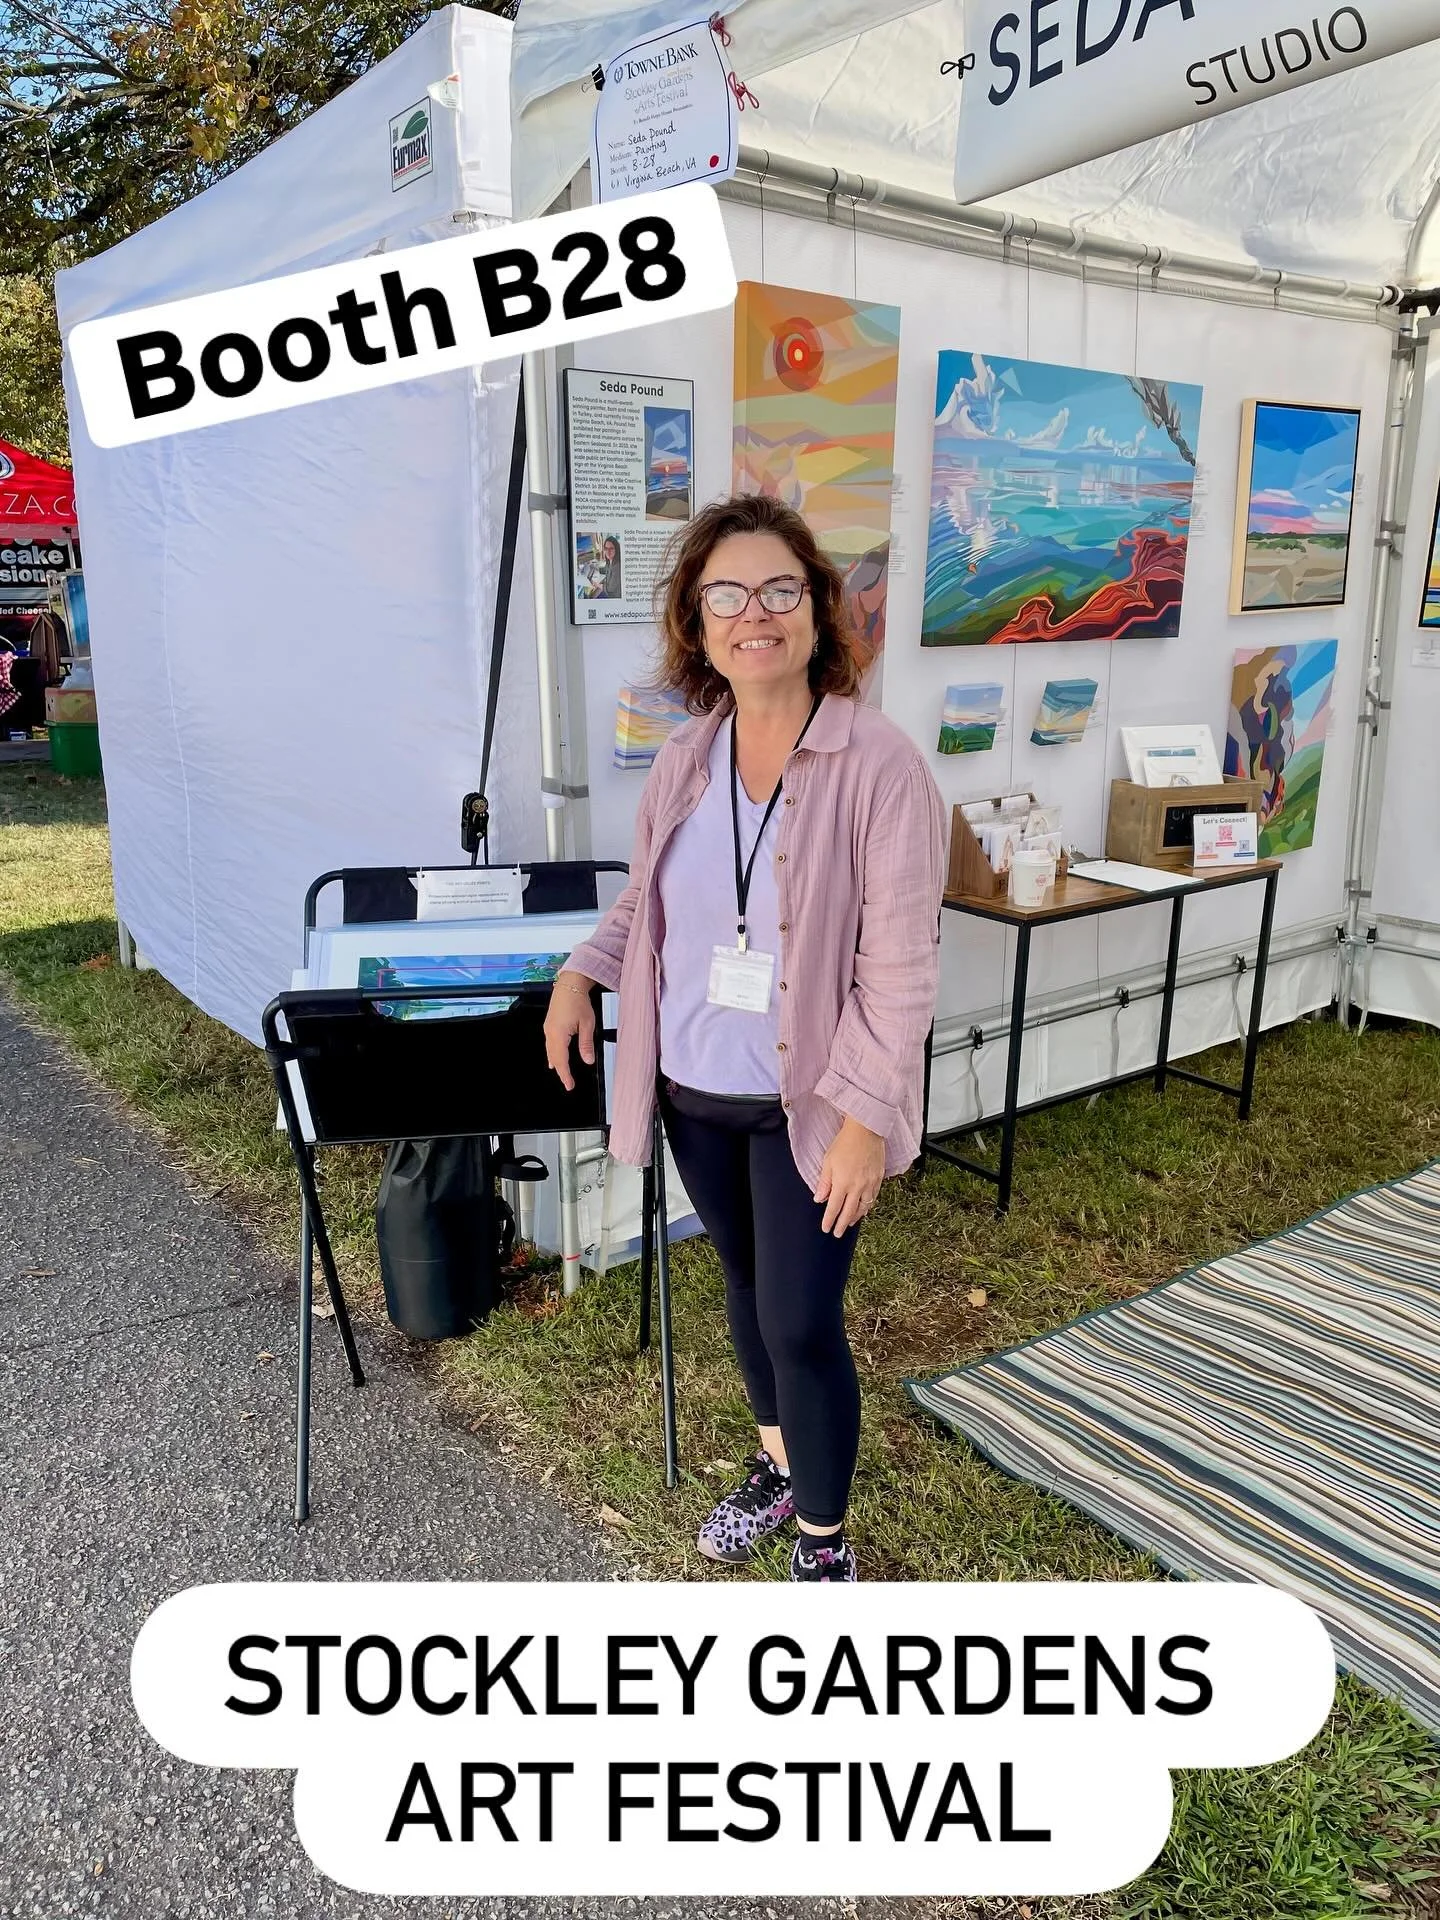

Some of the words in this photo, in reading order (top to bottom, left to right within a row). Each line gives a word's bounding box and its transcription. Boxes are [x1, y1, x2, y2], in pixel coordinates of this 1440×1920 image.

[1186, 7, 1367, 105] STUDIO
[624, 79, 658, 101] Stockley
[659, 70, 694, 90] Gardens
[656, 86, 688, 108] Festival
[628, 132, 647, 145] Seda
[649, 120, 676, 141] Pound
[686, 158, 697, 170] VA
[600, 380, 627, 394] Seda
[630, 383, 664, 397] Pound
